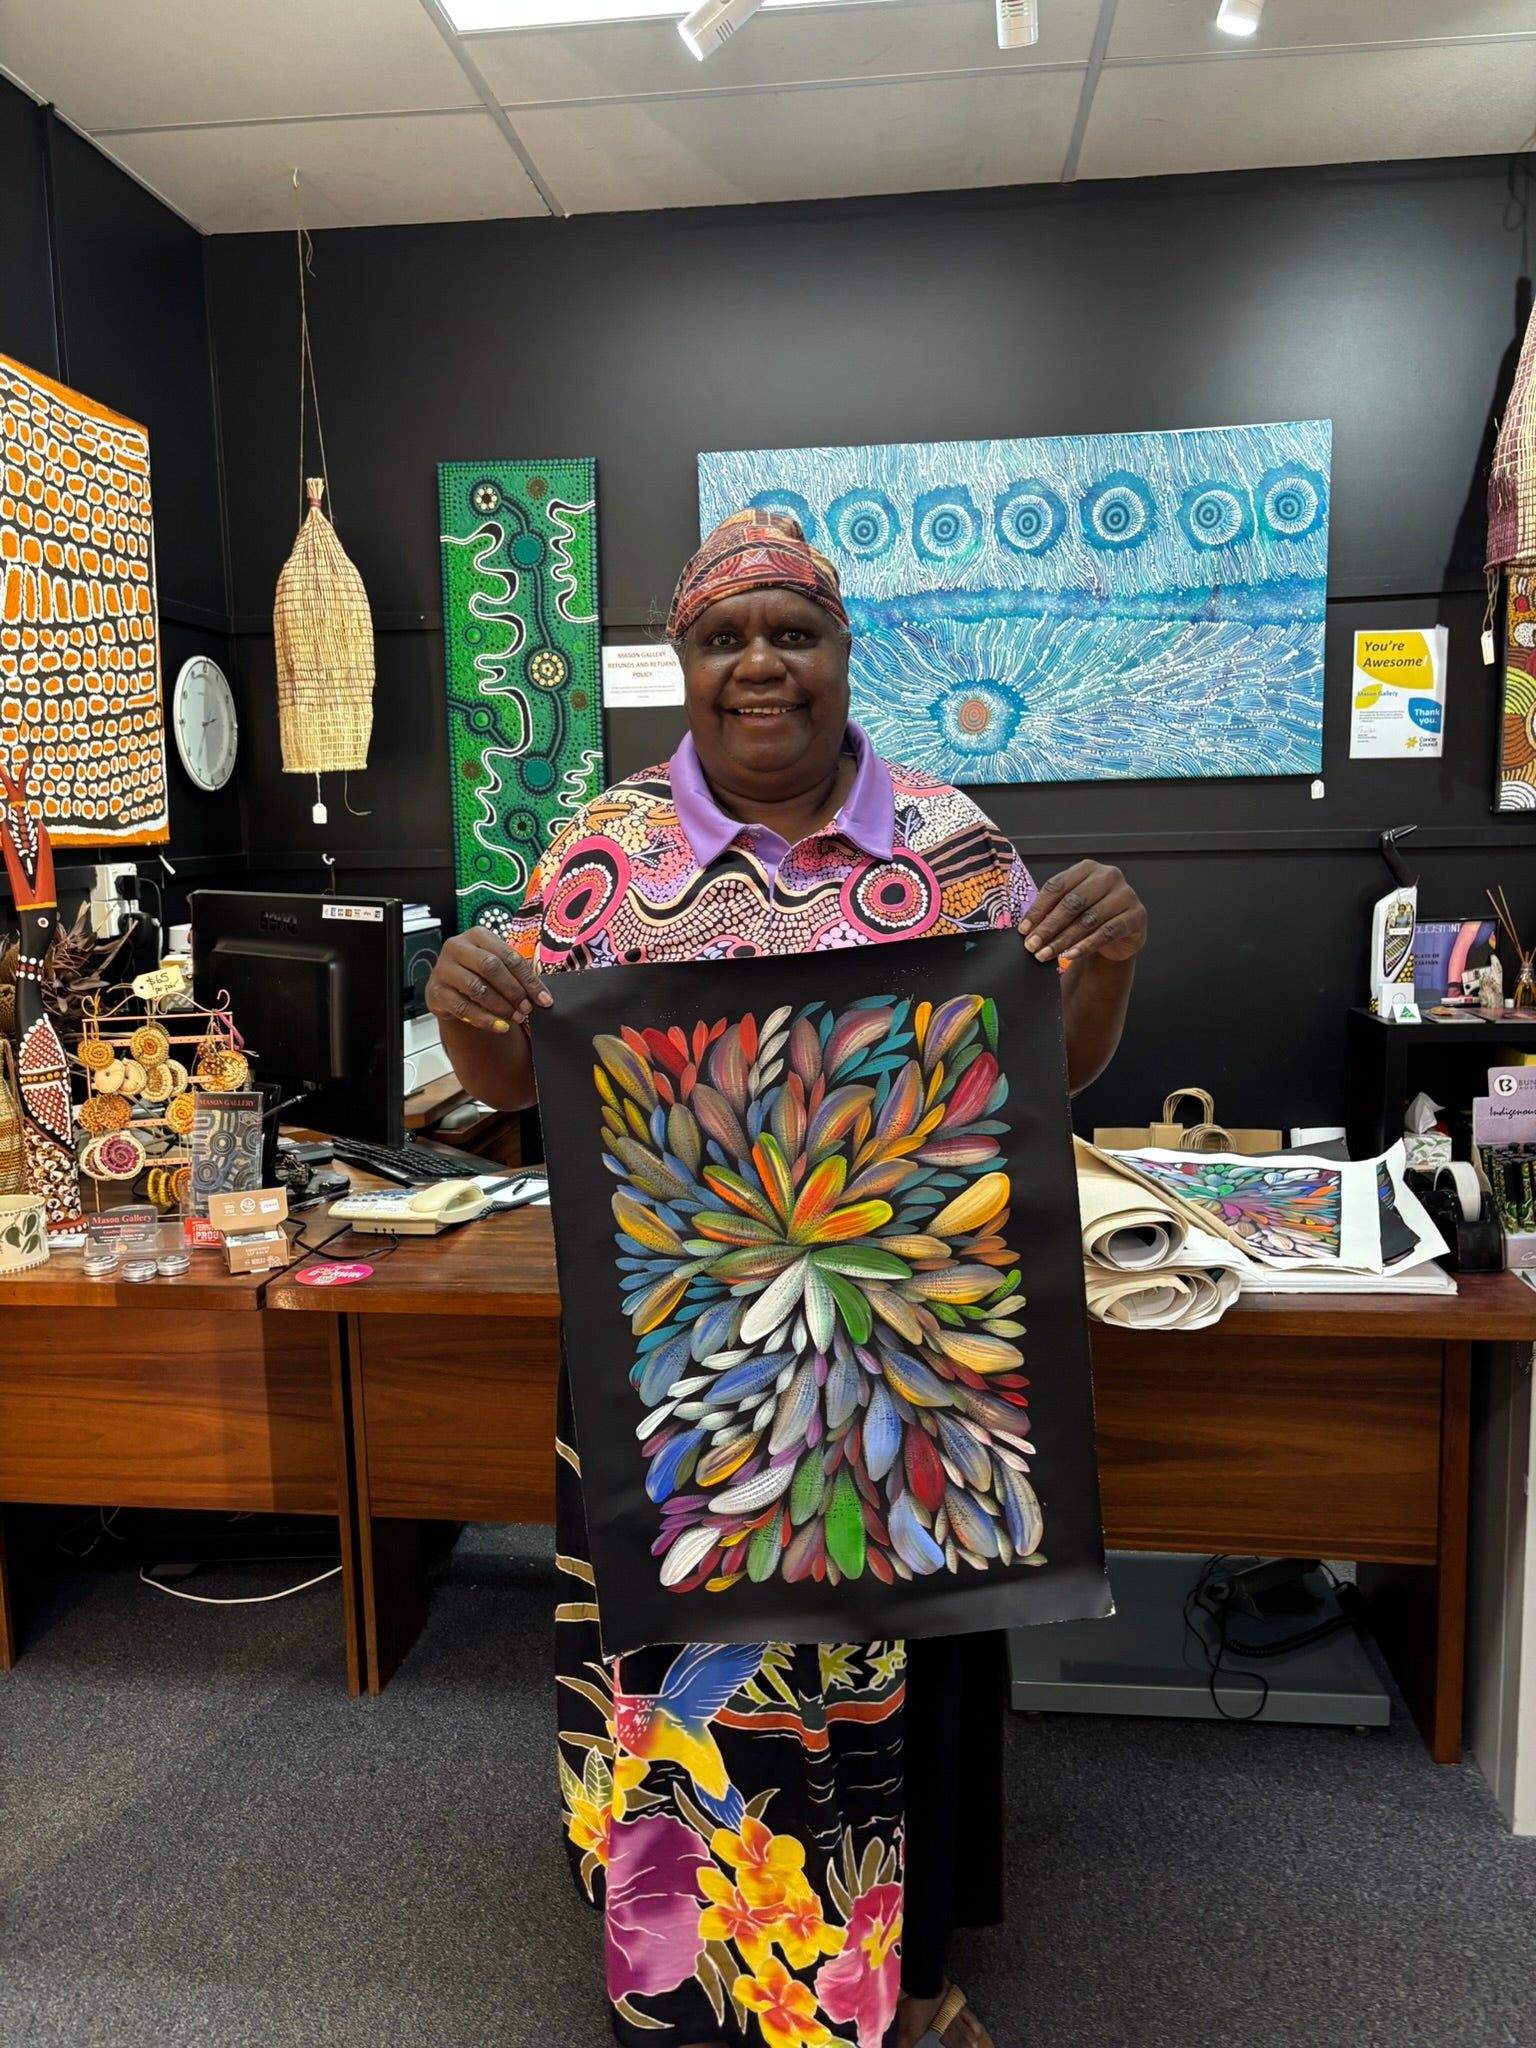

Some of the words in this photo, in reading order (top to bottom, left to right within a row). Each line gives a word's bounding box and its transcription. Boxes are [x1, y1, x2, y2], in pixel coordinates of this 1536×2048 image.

[1365, 641, 1405, 652] You're
[1362, 656, 1428, 668] Awesome!
[1414, 708, 1440, 716] Thank
[145, 972, 169, 990] $65
[164, 980, 179, 993] pair
[199, 1098, 223, 1106] MASON
[224, 1099, 254, 1107] GALLERY
[92, 1216, 119, 1225] Mason
[121, 1214, 152, 1224] Gallery
[195, 1231, 219, 1240] PROU
